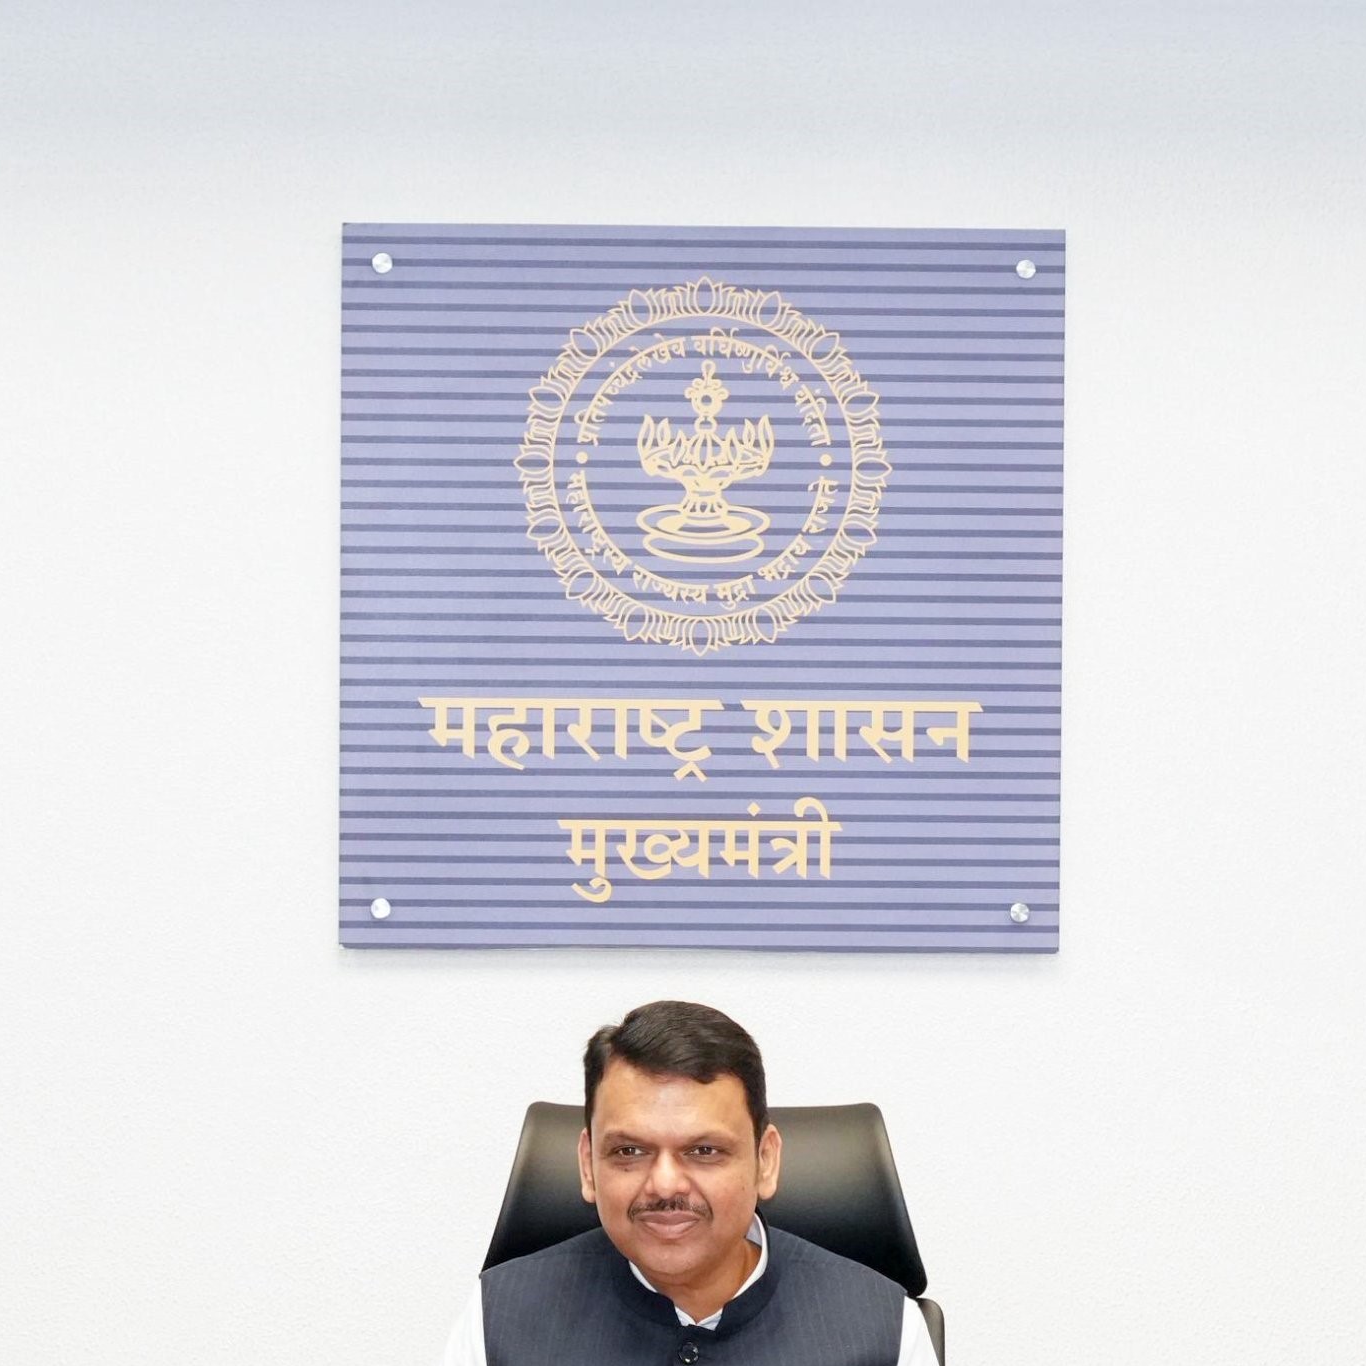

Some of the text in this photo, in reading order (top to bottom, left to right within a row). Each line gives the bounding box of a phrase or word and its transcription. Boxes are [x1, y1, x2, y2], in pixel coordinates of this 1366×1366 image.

[418, 696, 985, 783] महाराष्ट्र शासन
[557, 796, 843, 903] मुख्यमंत्री
